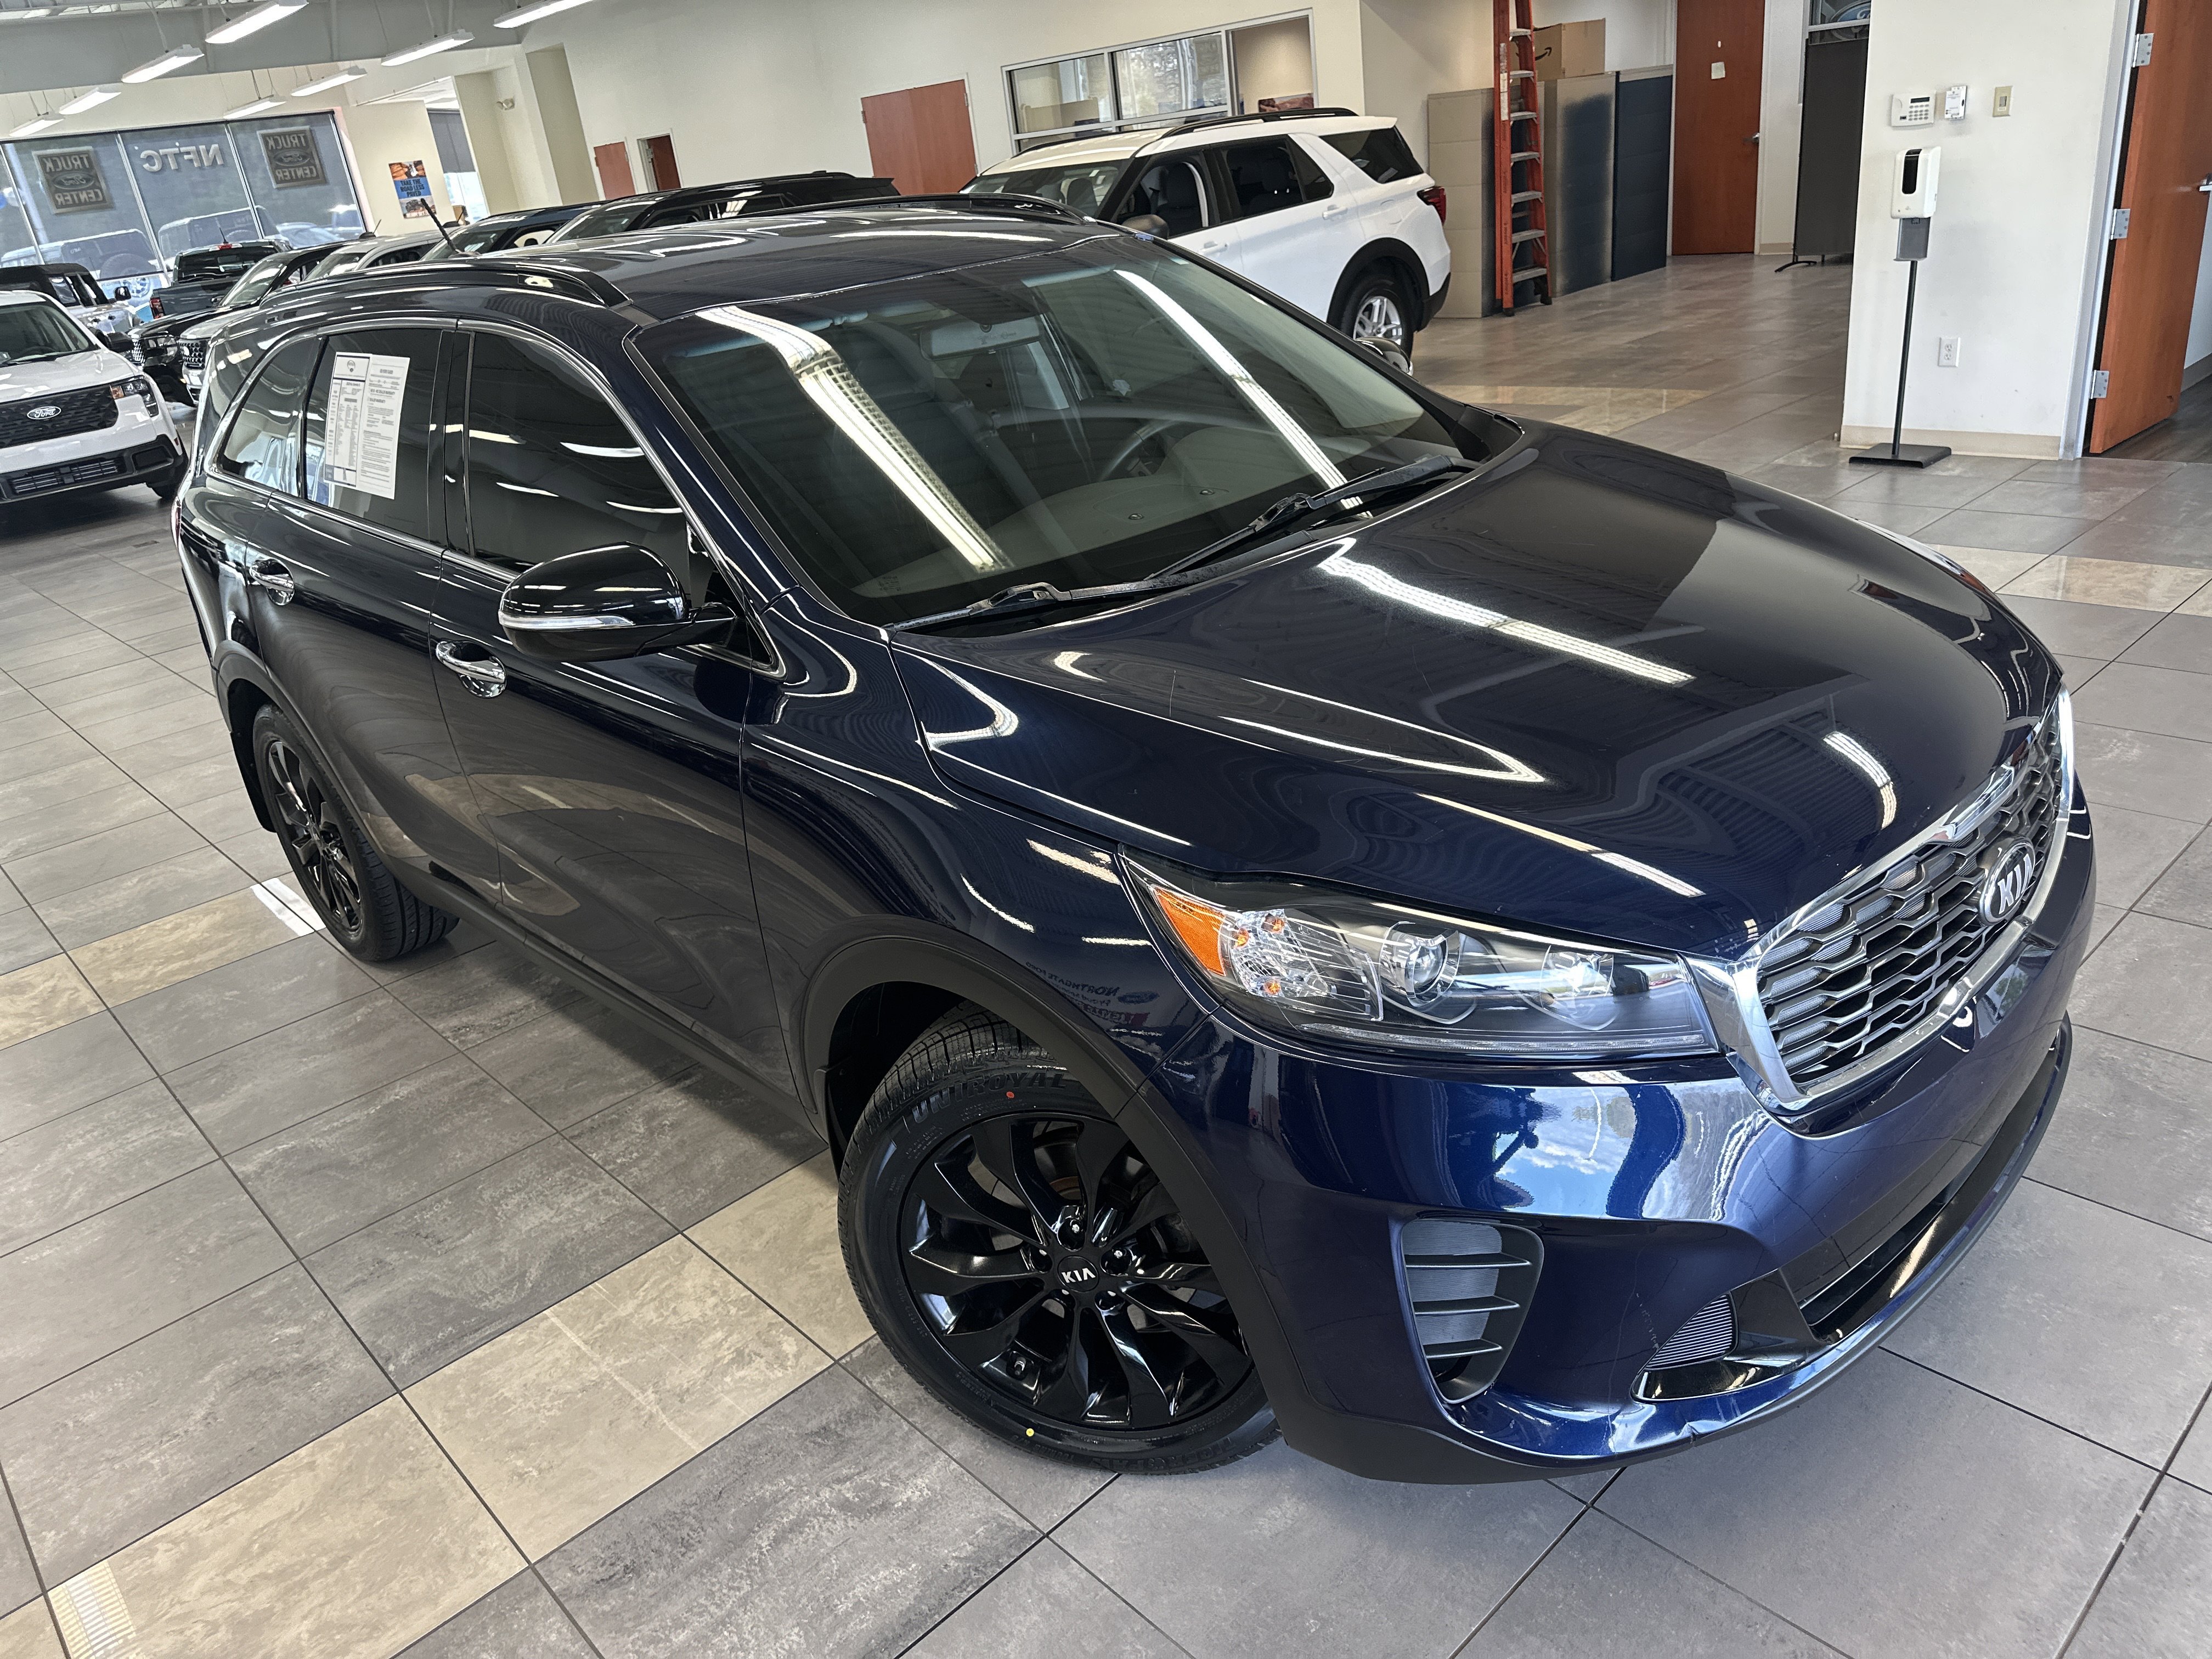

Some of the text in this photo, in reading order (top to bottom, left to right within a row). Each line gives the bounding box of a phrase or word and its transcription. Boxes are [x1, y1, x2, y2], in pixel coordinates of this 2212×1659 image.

[34, 408, 56, 418] Ford
[1997, 854, 2033, 915] KIA
[911, 1071, 1067, 1124] UNIROYAL
[1061, 1267, 1096, 1283] KIA
